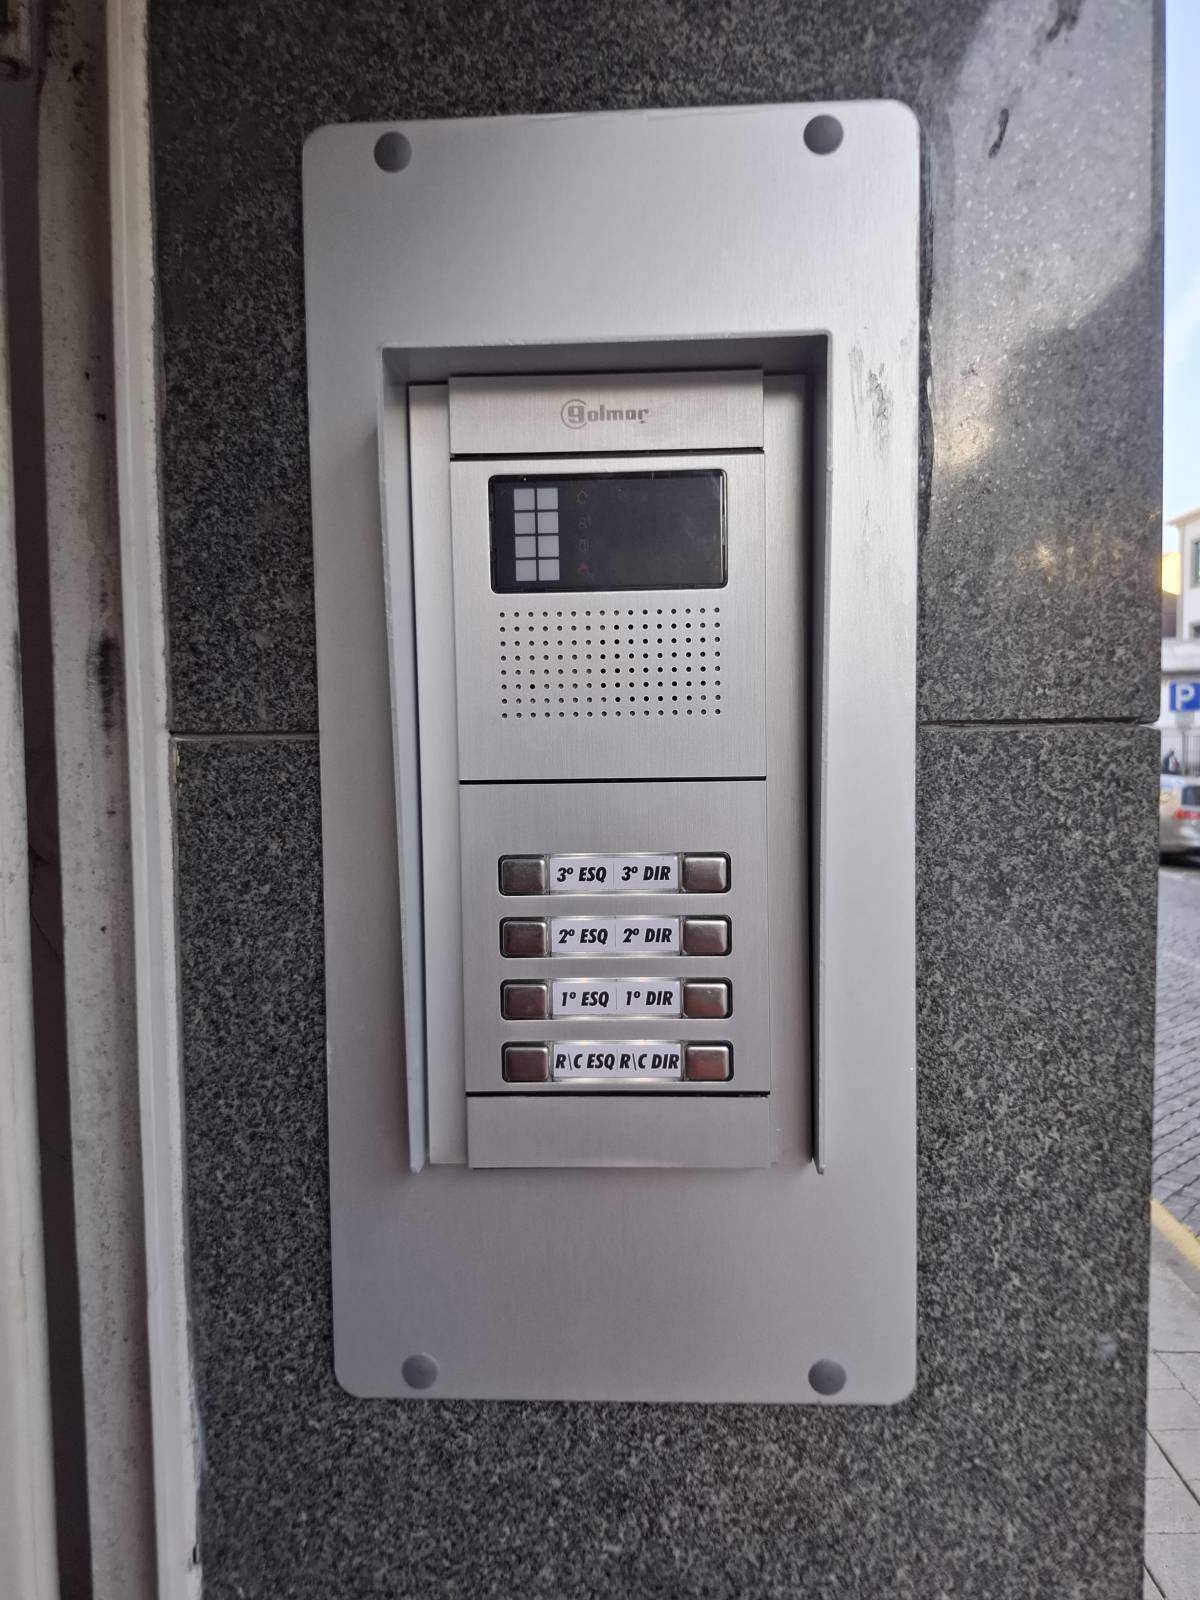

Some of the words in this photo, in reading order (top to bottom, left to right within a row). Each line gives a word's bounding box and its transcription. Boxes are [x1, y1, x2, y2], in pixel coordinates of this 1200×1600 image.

[561, 399, 649, 430] golmar
[1176, 683, 1195, 711] P
[578, 867, 607, 883] ESQ
[643, 866, 671, 881] DIR
[580, 929, 609, 945] ESQ
[644, 928, 673, 943] DIR
[581, 992, 610, 1008] ESQ
[645, 991, 674, 1006] DIR
[555, 1053, 583, 1071] R\C
[586, 1053, 615, 1071] ESQ
[619, 1053, 647, 1071] R\C
[651, 1053, 680, 1069] DIR
